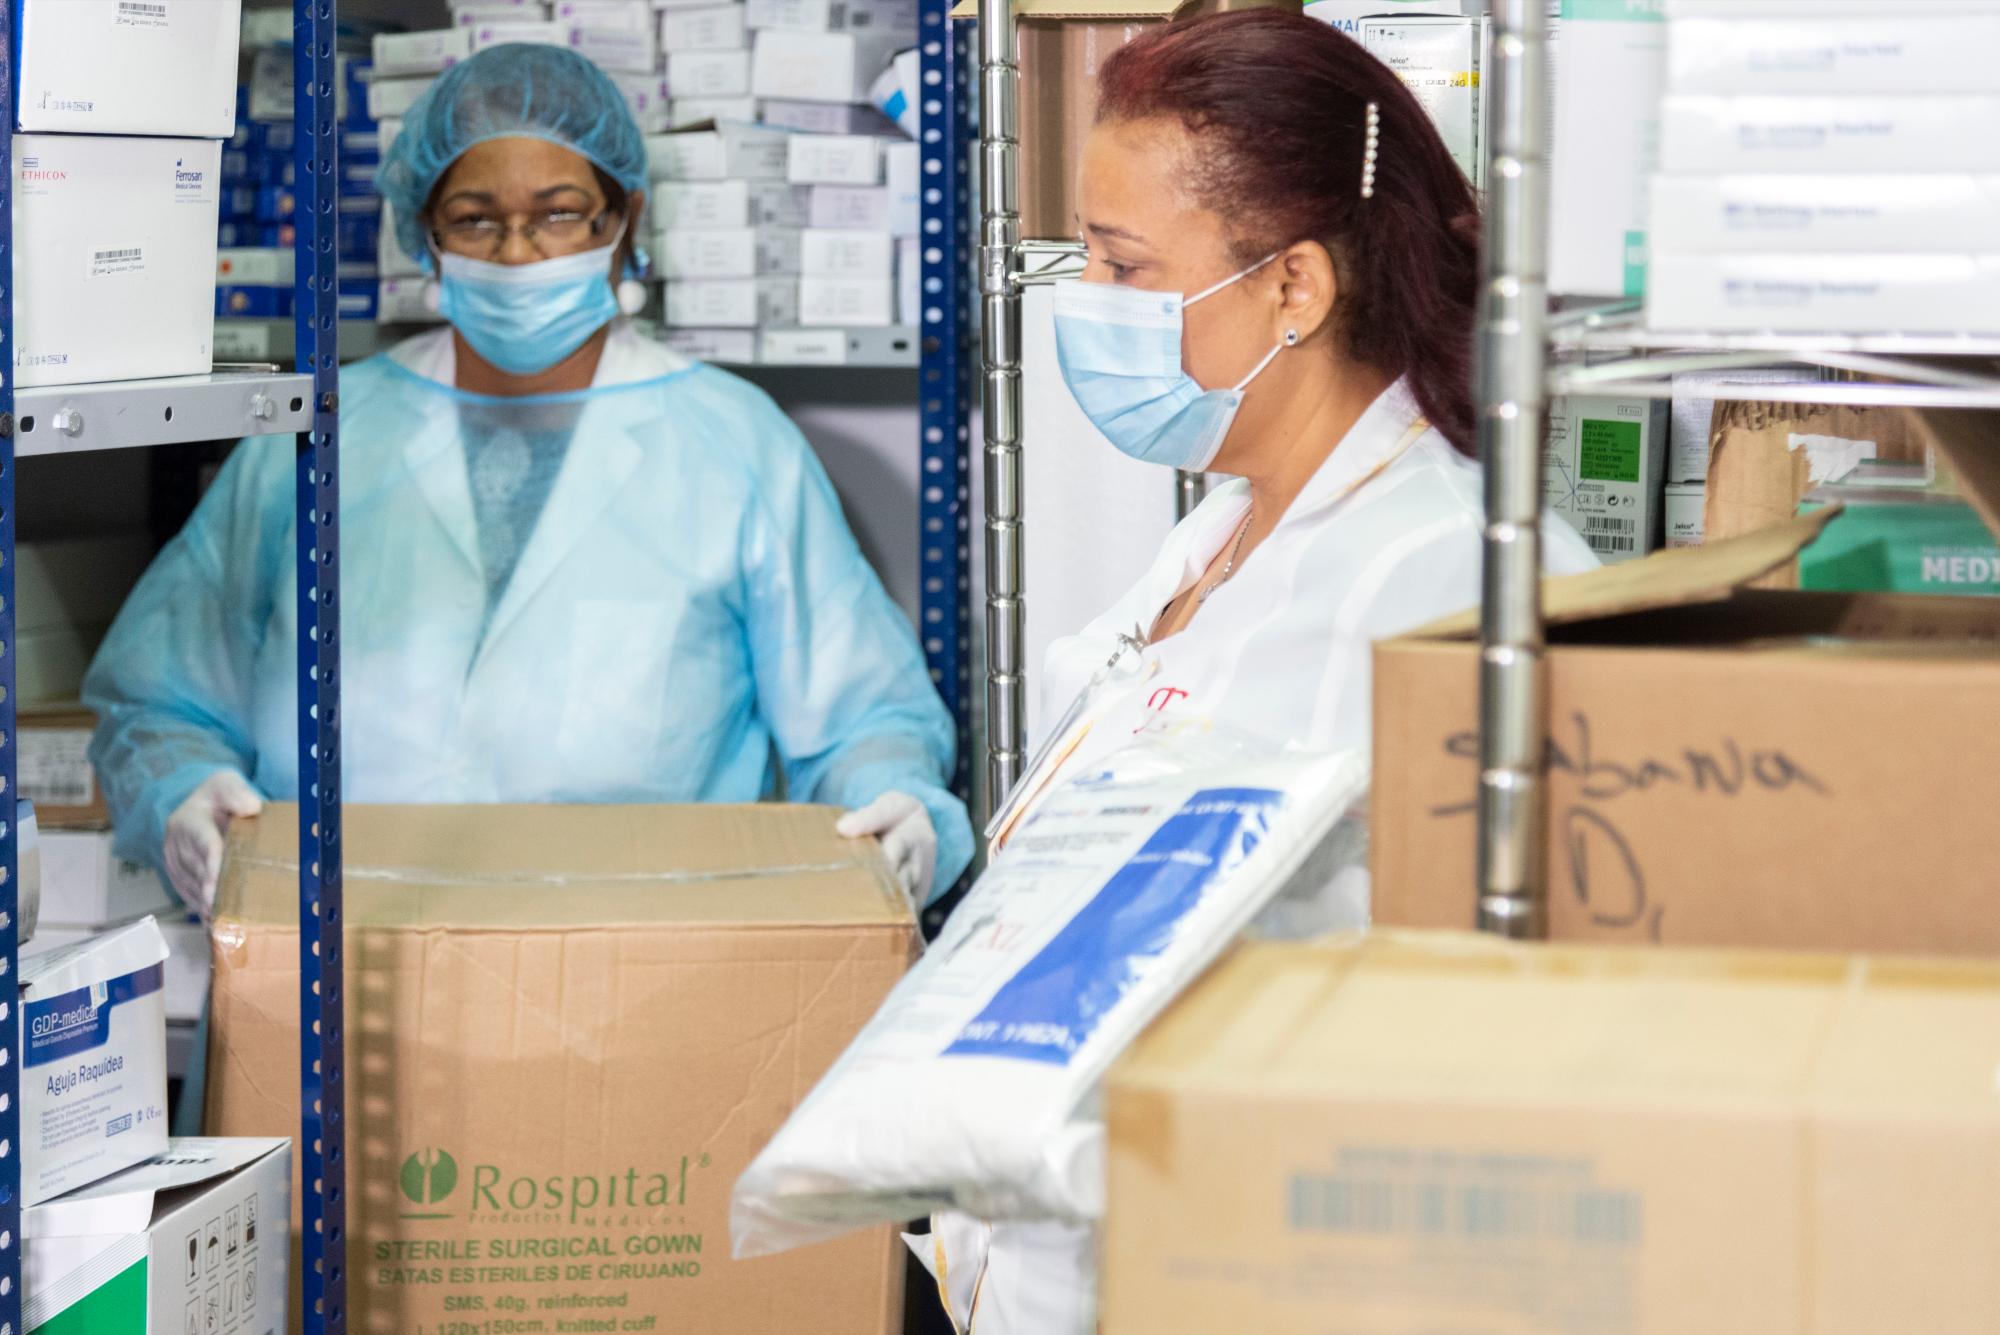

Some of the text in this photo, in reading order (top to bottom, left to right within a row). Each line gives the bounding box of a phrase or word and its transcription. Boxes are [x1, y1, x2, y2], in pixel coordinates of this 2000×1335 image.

[22, 171, 67, 180] ETHICON
[176, 170, 202, 182] Ferrosan
[46, 1054, 124, 1095] Aguja Raquídea
[469, 1212, 562, 1225] Productos
[375, 1233, 703, 1261] STERILE SURGICAL GOWN
[449, 1265, 559, 1284] ESTERILES
[566, 1264, 592, 1281] DE
[598, 1261, 702, 1281] CIRUJANO
[537, 1292, 628, 1309] reinforced
[556, 1317, 617, 1333] knitted
[622, 1315, 657, 1331] cuff
